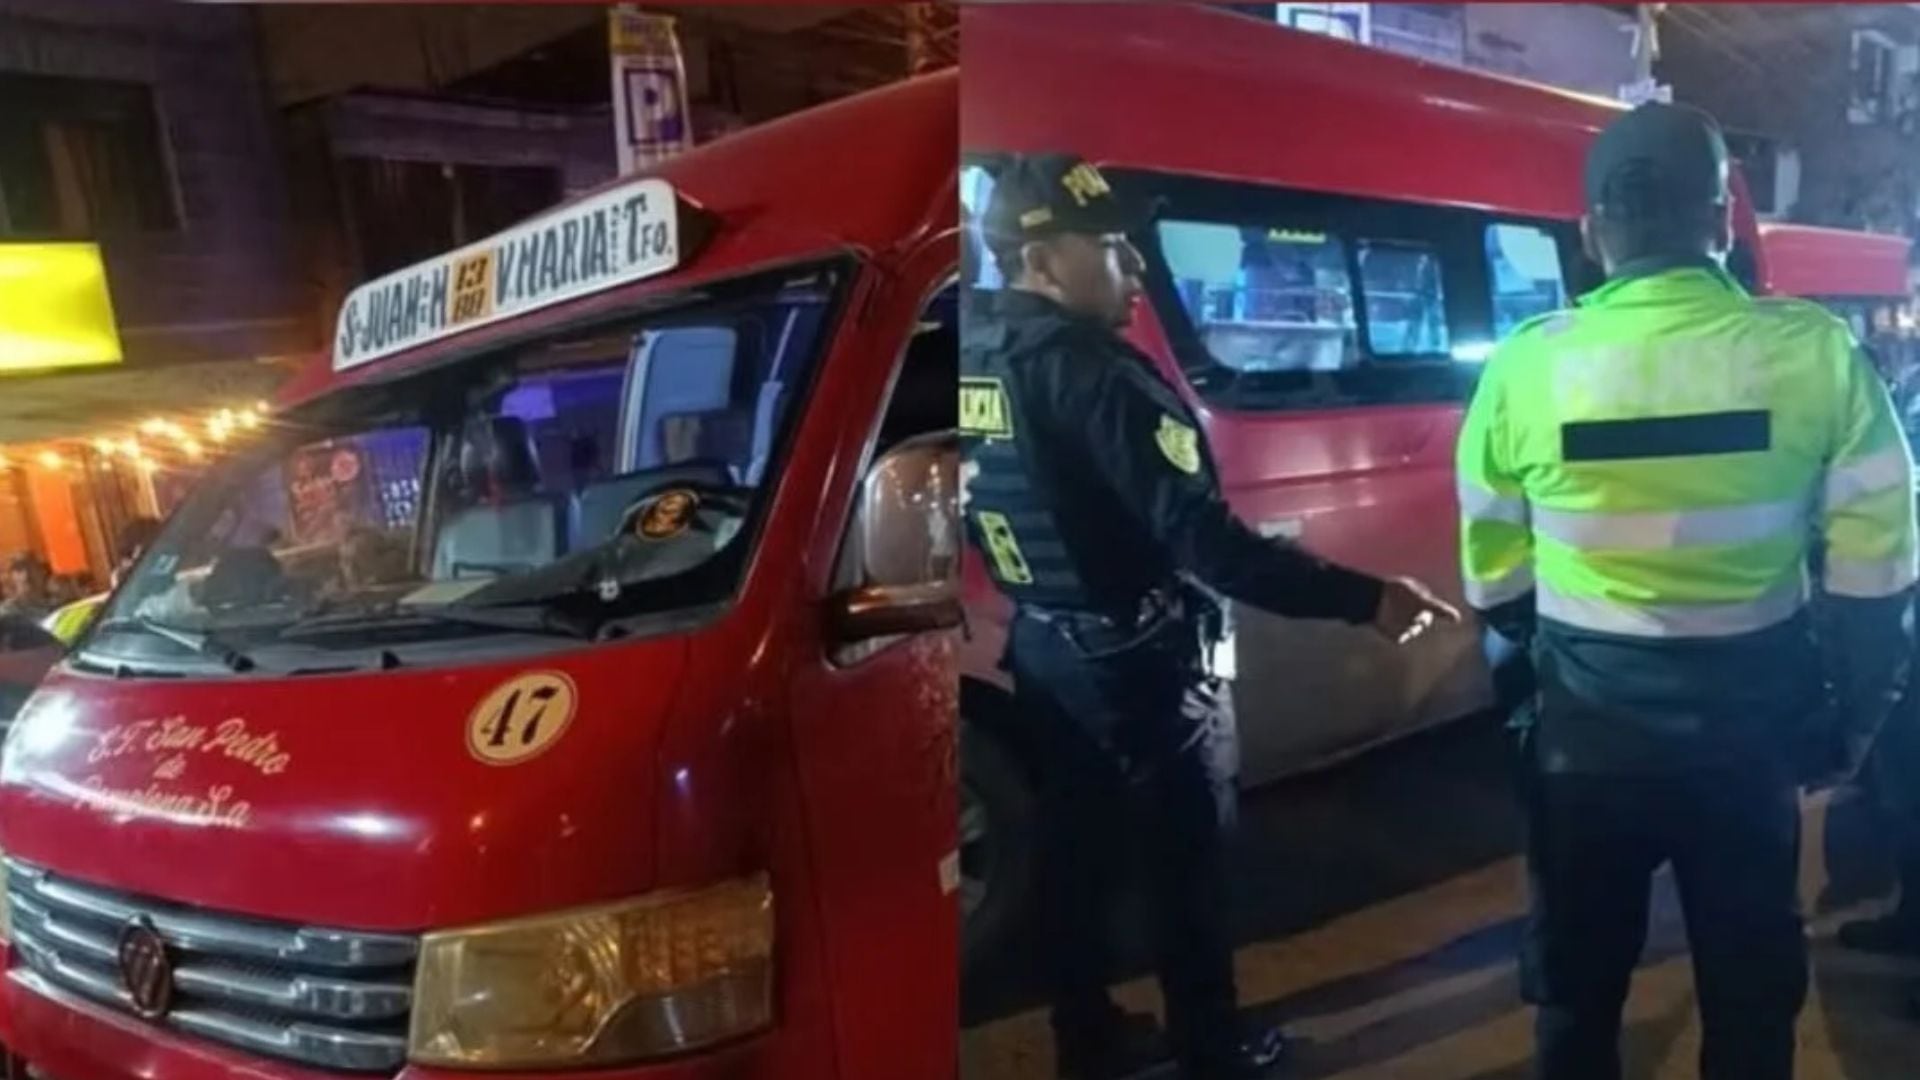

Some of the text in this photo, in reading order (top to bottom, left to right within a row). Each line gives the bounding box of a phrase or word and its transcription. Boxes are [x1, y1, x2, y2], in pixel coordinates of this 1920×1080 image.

[145, 714, 207, 749] San
[201, 717, 290, 774] Pedro
[480, 686, 559, 746] 47
[152, 751, 187, 780] de
